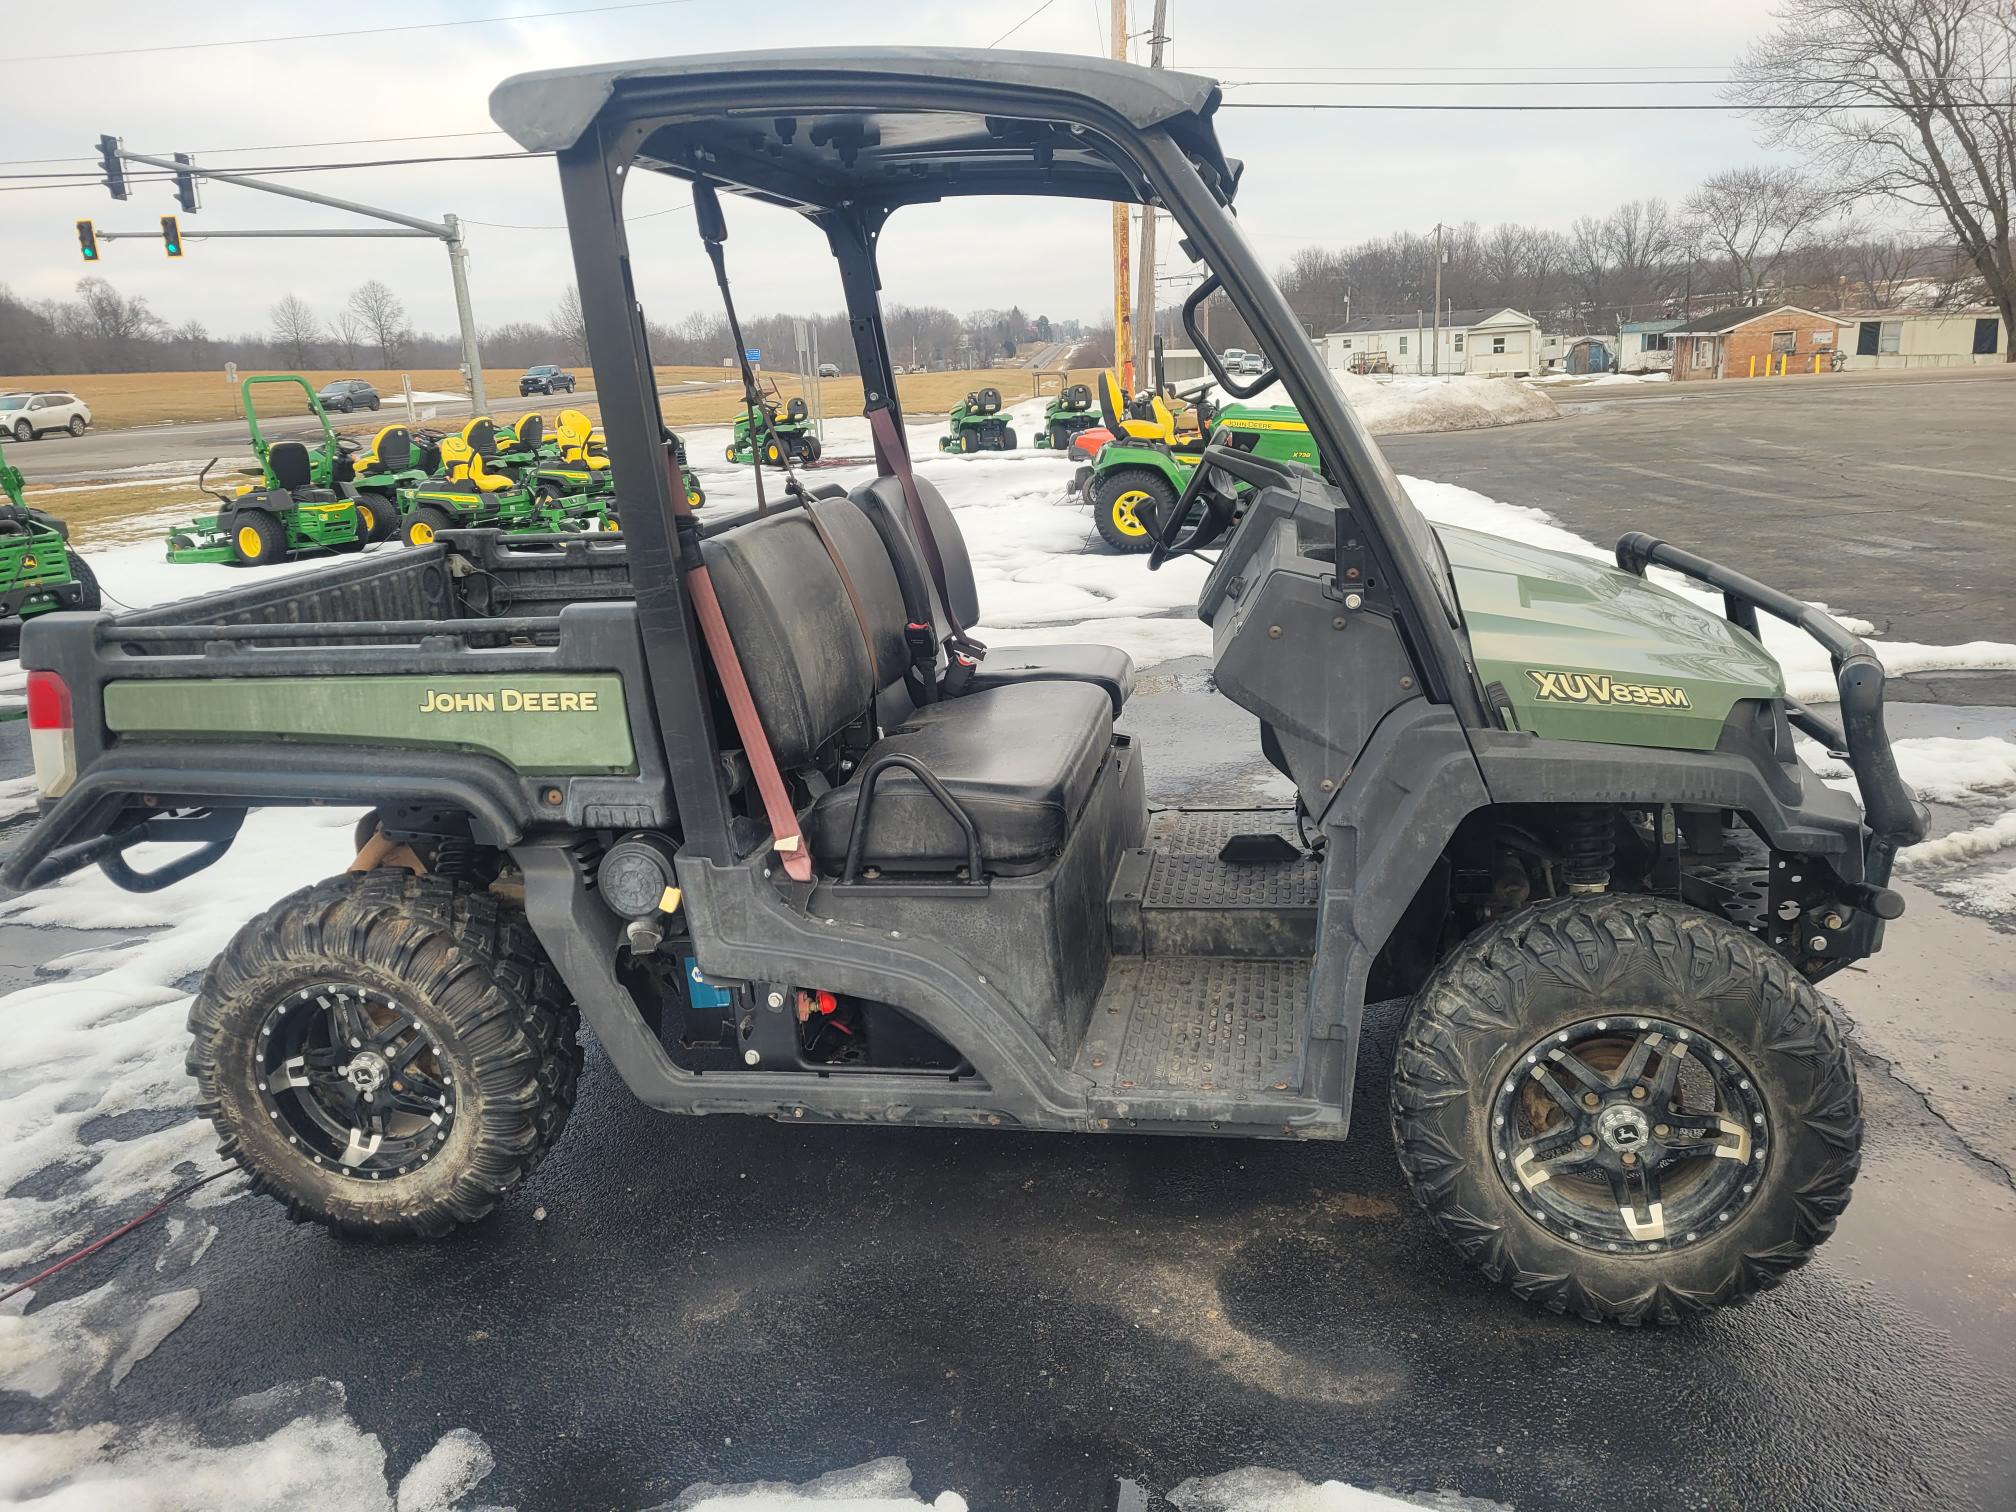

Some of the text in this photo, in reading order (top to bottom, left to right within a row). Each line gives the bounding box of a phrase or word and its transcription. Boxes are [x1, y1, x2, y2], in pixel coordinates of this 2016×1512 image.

[1228, 420, 1249, 428] JOHN
[419, 688, 598, 713] JOHN DEERE
[1526, 670, 1692, 709] XUV835M
